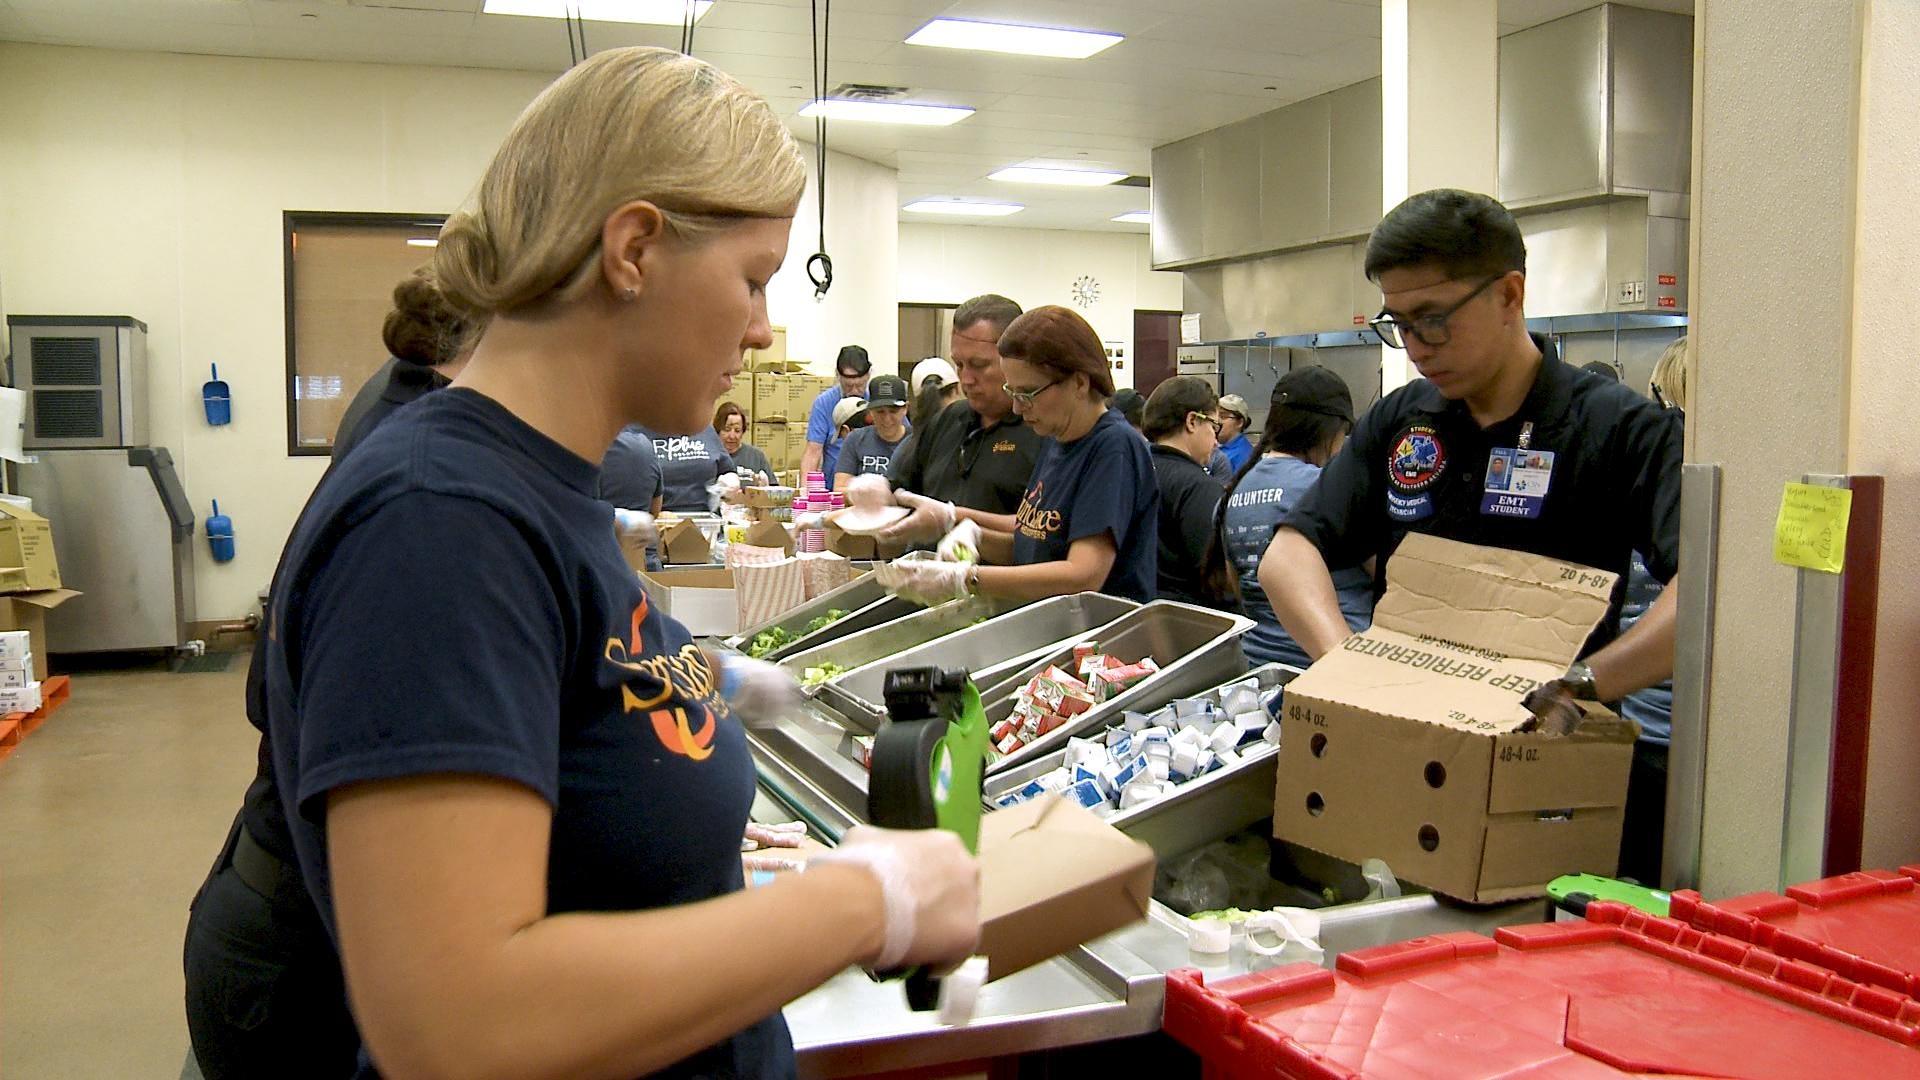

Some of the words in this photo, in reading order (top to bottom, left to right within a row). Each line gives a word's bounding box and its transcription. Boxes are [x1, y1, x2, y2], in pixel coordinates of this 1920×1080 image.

[862, 455, 890, 471] PR
[1498, 495, 1527, 506] EMT
[1489, 504, 1530, 515] STUDENT
[1577, 572, 1609, 588] 48-4
[1488, 674, 1543, 695] EEP
[1289, 704, 1311, 723] 48-4
[1500, 745, 1523, 762] 48-4
